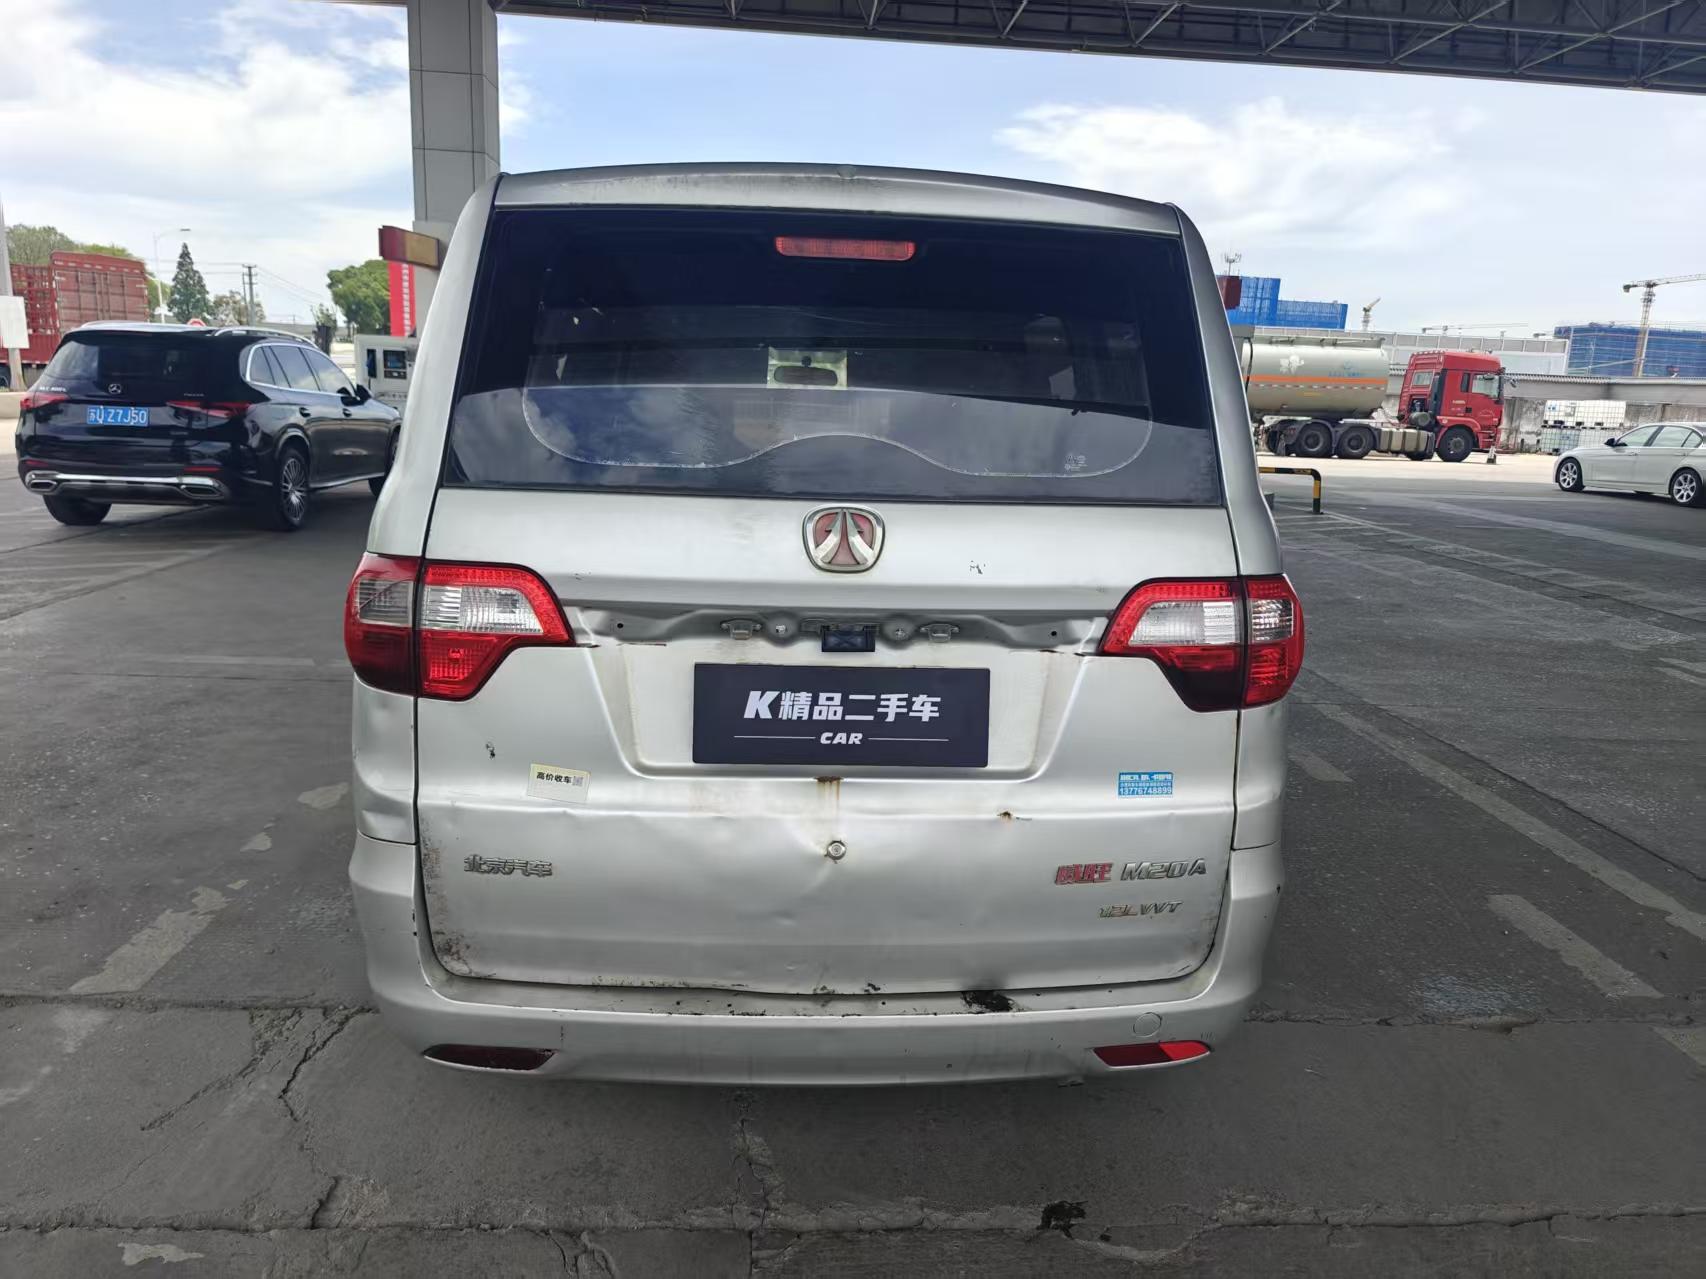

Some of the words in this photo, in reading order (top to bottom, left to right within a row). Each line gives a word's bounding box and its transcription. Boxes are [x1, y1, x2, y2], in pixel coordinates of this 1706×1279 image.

[819, 732, 863, 745] CAR
[536, 771, 572, 784] 高价收车
[463, 854, 553, 877] 北京汽车
[1120, 858, 1207, 881] M20A
